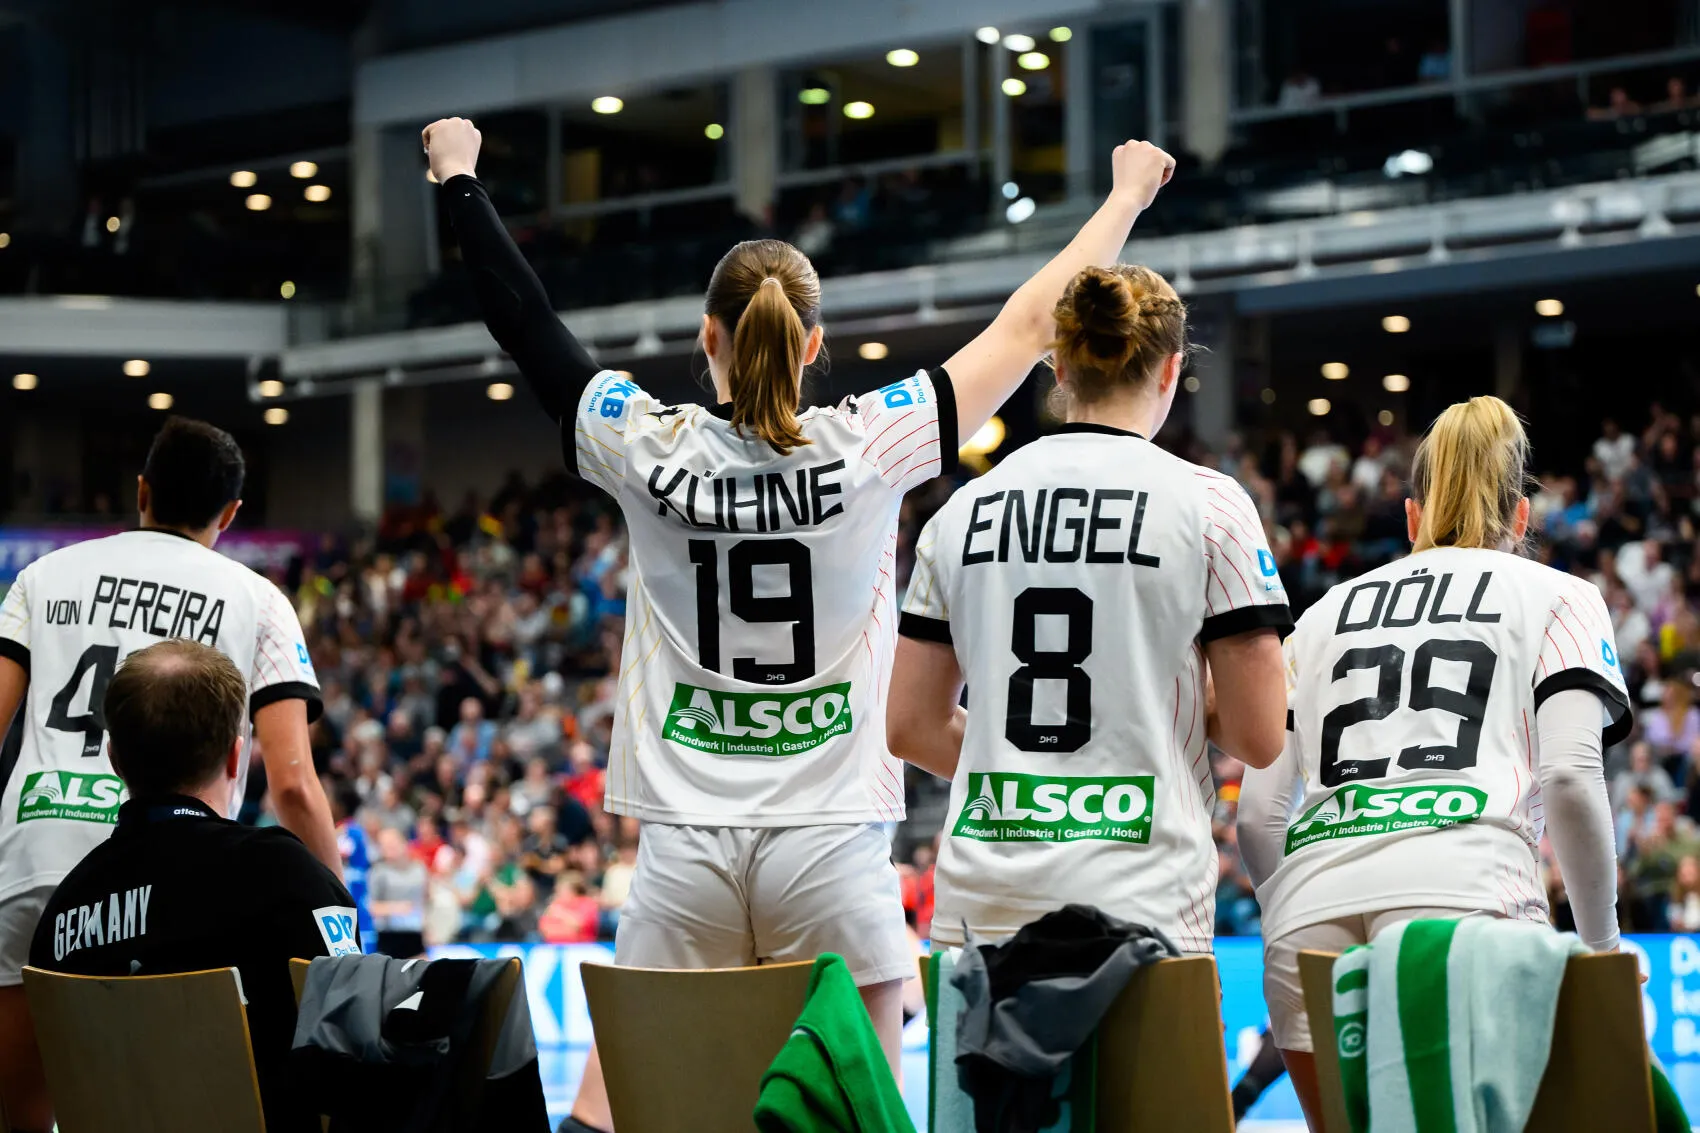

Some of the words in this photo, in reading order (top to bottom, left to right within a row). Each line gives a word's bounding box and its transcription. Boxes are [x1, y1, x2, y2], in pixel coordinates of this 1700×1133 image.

[648, 459, 846, 532] KÜHNE
[962, 487, 1160, 568] ENGEL
[46, 600, 82, 625] VON
[88, 575, 225, 647] PEREIRA
[688, 538, 816, 686] 19
[1335, 568, 1502, 635] DÖLL
[1005, 587, 1093, 753] 8
[670, 688, 846, 739] ALSCO
[671, 729, 719, 750] Handwerk
[727, 743, 774, 753] Industrie
[782, 739, 817, 752] Gastro
[823, 721, 847, 739] Hotel
[1320, 638, 1498, 788] 29
[65, 808, 105, 820] Industrie
[963, 775, 1147, 824] ALSCO
[1289, 788, 1478, 835] ALSCO
[1006, 827, 1055, 838] Industrie
[1064, 828, 1102, 838] Gastro
[1111, 827, 1142, 840] Hotel
[1291, 829, 1331, 849] Handwerk
[1338, 822, 1384, 835] Industrie
[1392, 820, 1429, 829] Gastro
[54, 884, 152, 961] GERMANY
